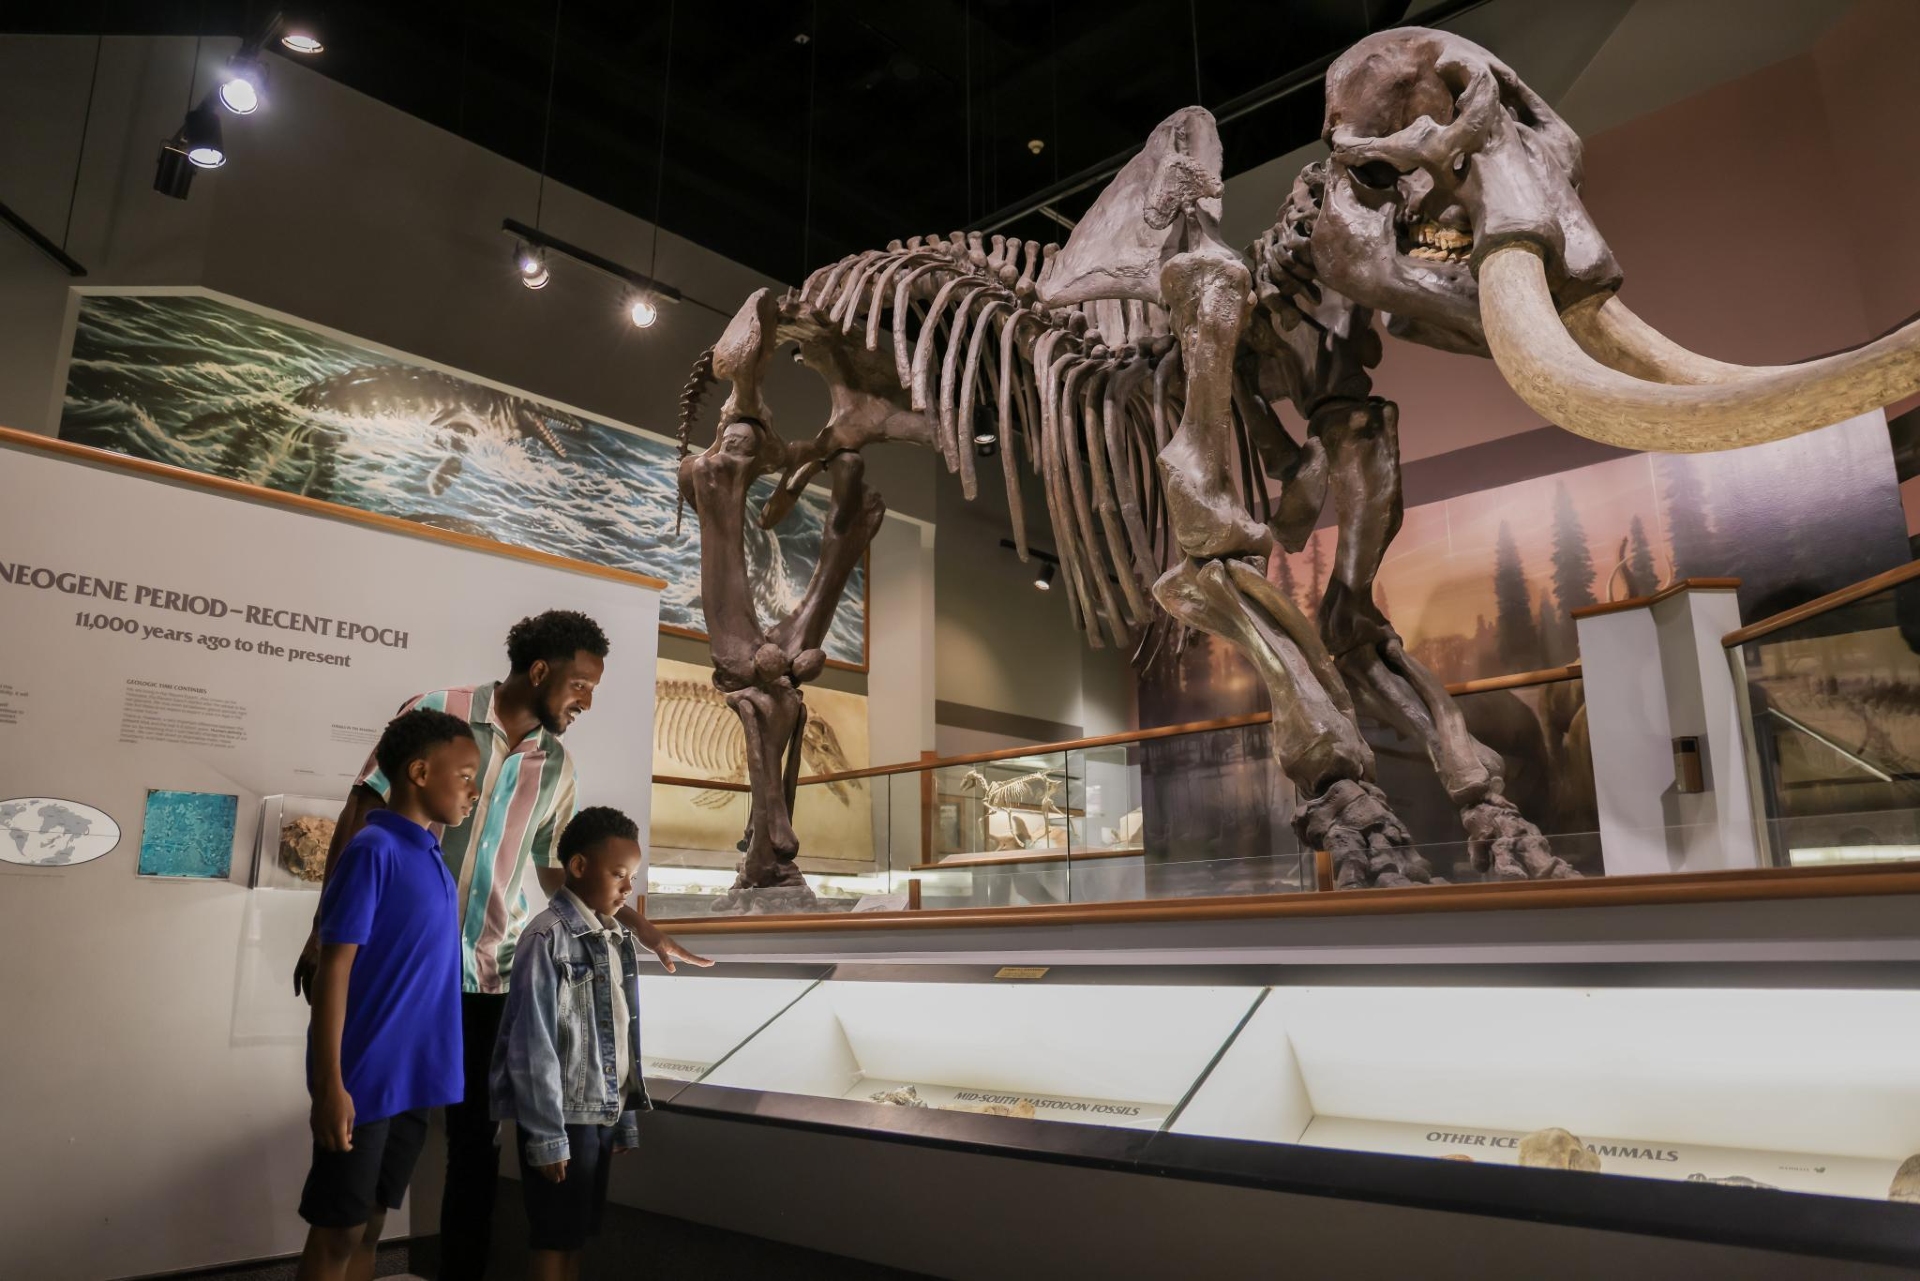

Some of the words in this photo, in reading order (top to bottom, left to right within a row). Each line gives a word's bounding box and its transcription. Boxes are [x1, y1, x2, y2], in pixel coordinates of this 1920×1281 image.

[0, 561, 128, 602] NEOGENE
[335, 620, 409, 649] EPOCH
[75, 611, 139, 634] 11,000
[141, 625, 193, 643] years
[197, 634, 231, 651] ago
[235, 637, 254, 652] to
[257, 640, 285, 657] the
[287, 648, 351, 667] present
[126, 679, 157, 688] GEOLOGIC
[954, 1091, 1020, 1105] MID-SOUTH
[1090, 1104, 1141, 1116] FOSSILS
[1426, 1131, 1486, 1146] OTHER
[1489, 1136, 1519, 1149] ICE
[1586, 1144, 1679, 1162] AMMALS
